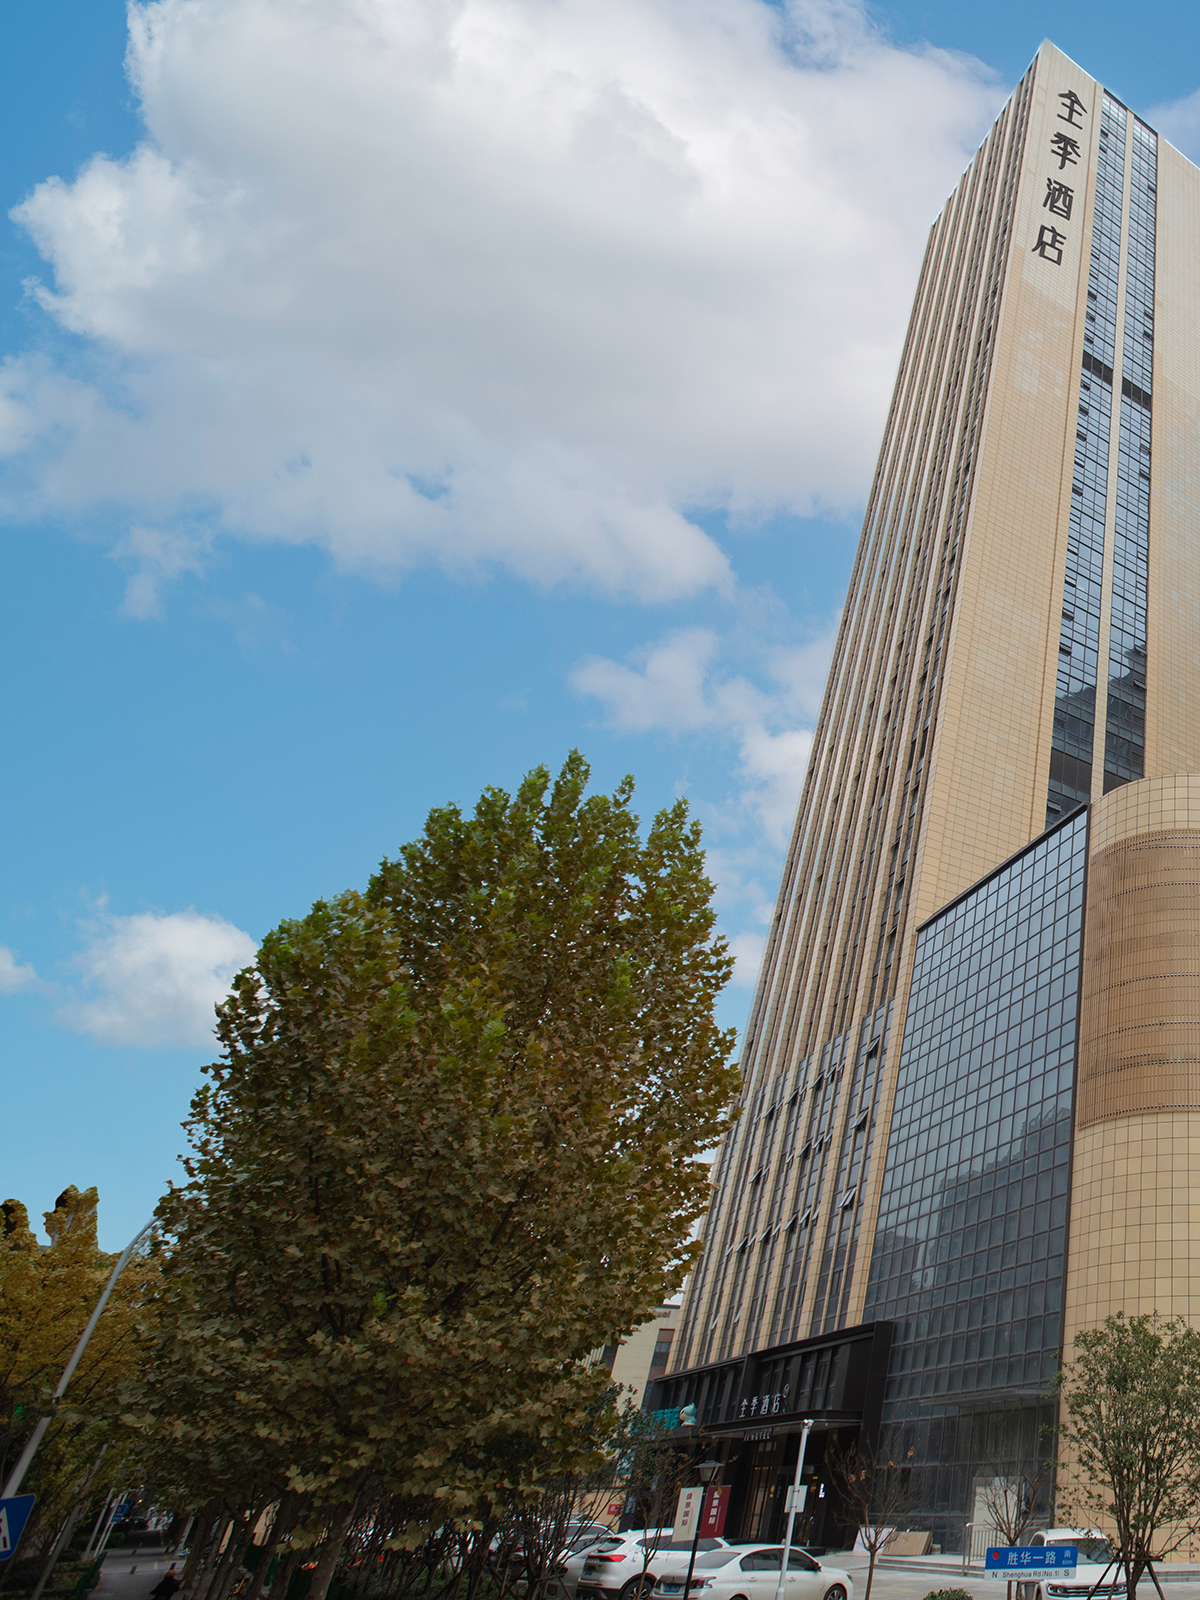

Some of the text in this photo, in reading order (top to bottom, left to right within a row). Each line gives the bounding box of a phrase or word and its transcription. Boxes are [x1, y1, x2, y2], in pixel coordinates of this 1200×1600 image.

[1031, 89, 1088, 266] 全季酒店
[738, 1393, 781, 1418] 全季酒店
[1007, 1550, 1056, 1565] 胜华一路
[1063, 1549, 1072, 1559] 南
[1002, 1571, 1032, 1579] Shenghua
[1063, 1568, 1070, 1577] S
